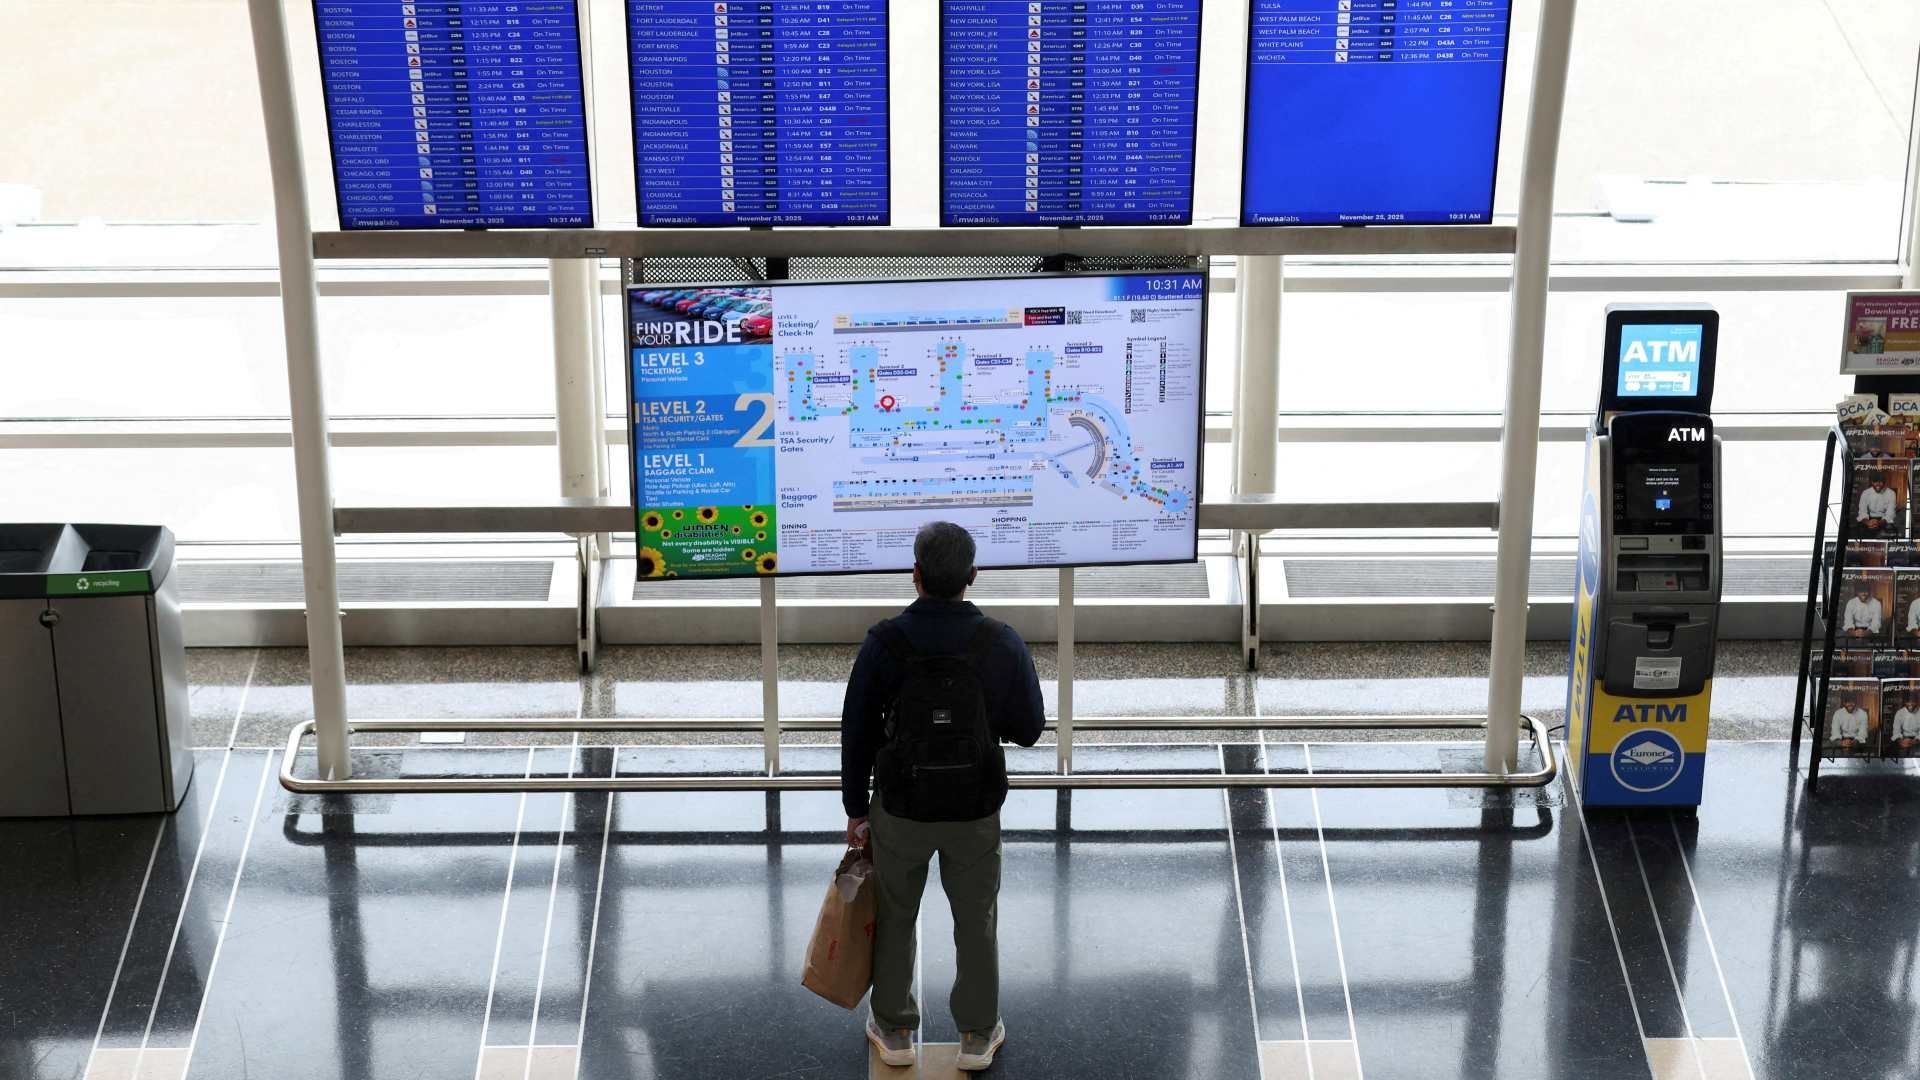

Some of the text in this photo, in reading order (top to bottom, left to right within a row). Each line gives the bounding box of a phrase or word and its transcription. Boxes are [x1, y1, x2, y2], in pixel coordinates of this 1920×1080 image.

[1146, 279, 1202, 290] 10:31 AM
[778, 320, 819, 329] Ticketing/
[1892, 317, 1920, 328] FRE
[636, 320, 741, 344] FIND RIDE
[637, 334, 671, 346] YOUR
[1622, 341, 1697, 363] ATM
[640, 352, 704, 367] LEVEL 3
[642, 400, 706, 416] LEVEL 2
[1840, 403, 1865, 416] DCA
[1894, 402, 1918, 411] DCA
[659, 414, 724, 424] SECURITY/GATES
[734, 392, 775, 448] 2
[797, 436, 834, 444] Security/
[1668, 427, 1705, 442] ATM
[644, 453, 705, 468] LEVEL 1
[781, 494, 817, 502] Baggage
[93, 580, 120, 588] recycling
[1574, 616, 1587, 720] ATM
[1613, 704, 1687, 723] ATM
[1629, 749, 1666, 758] Euronet
